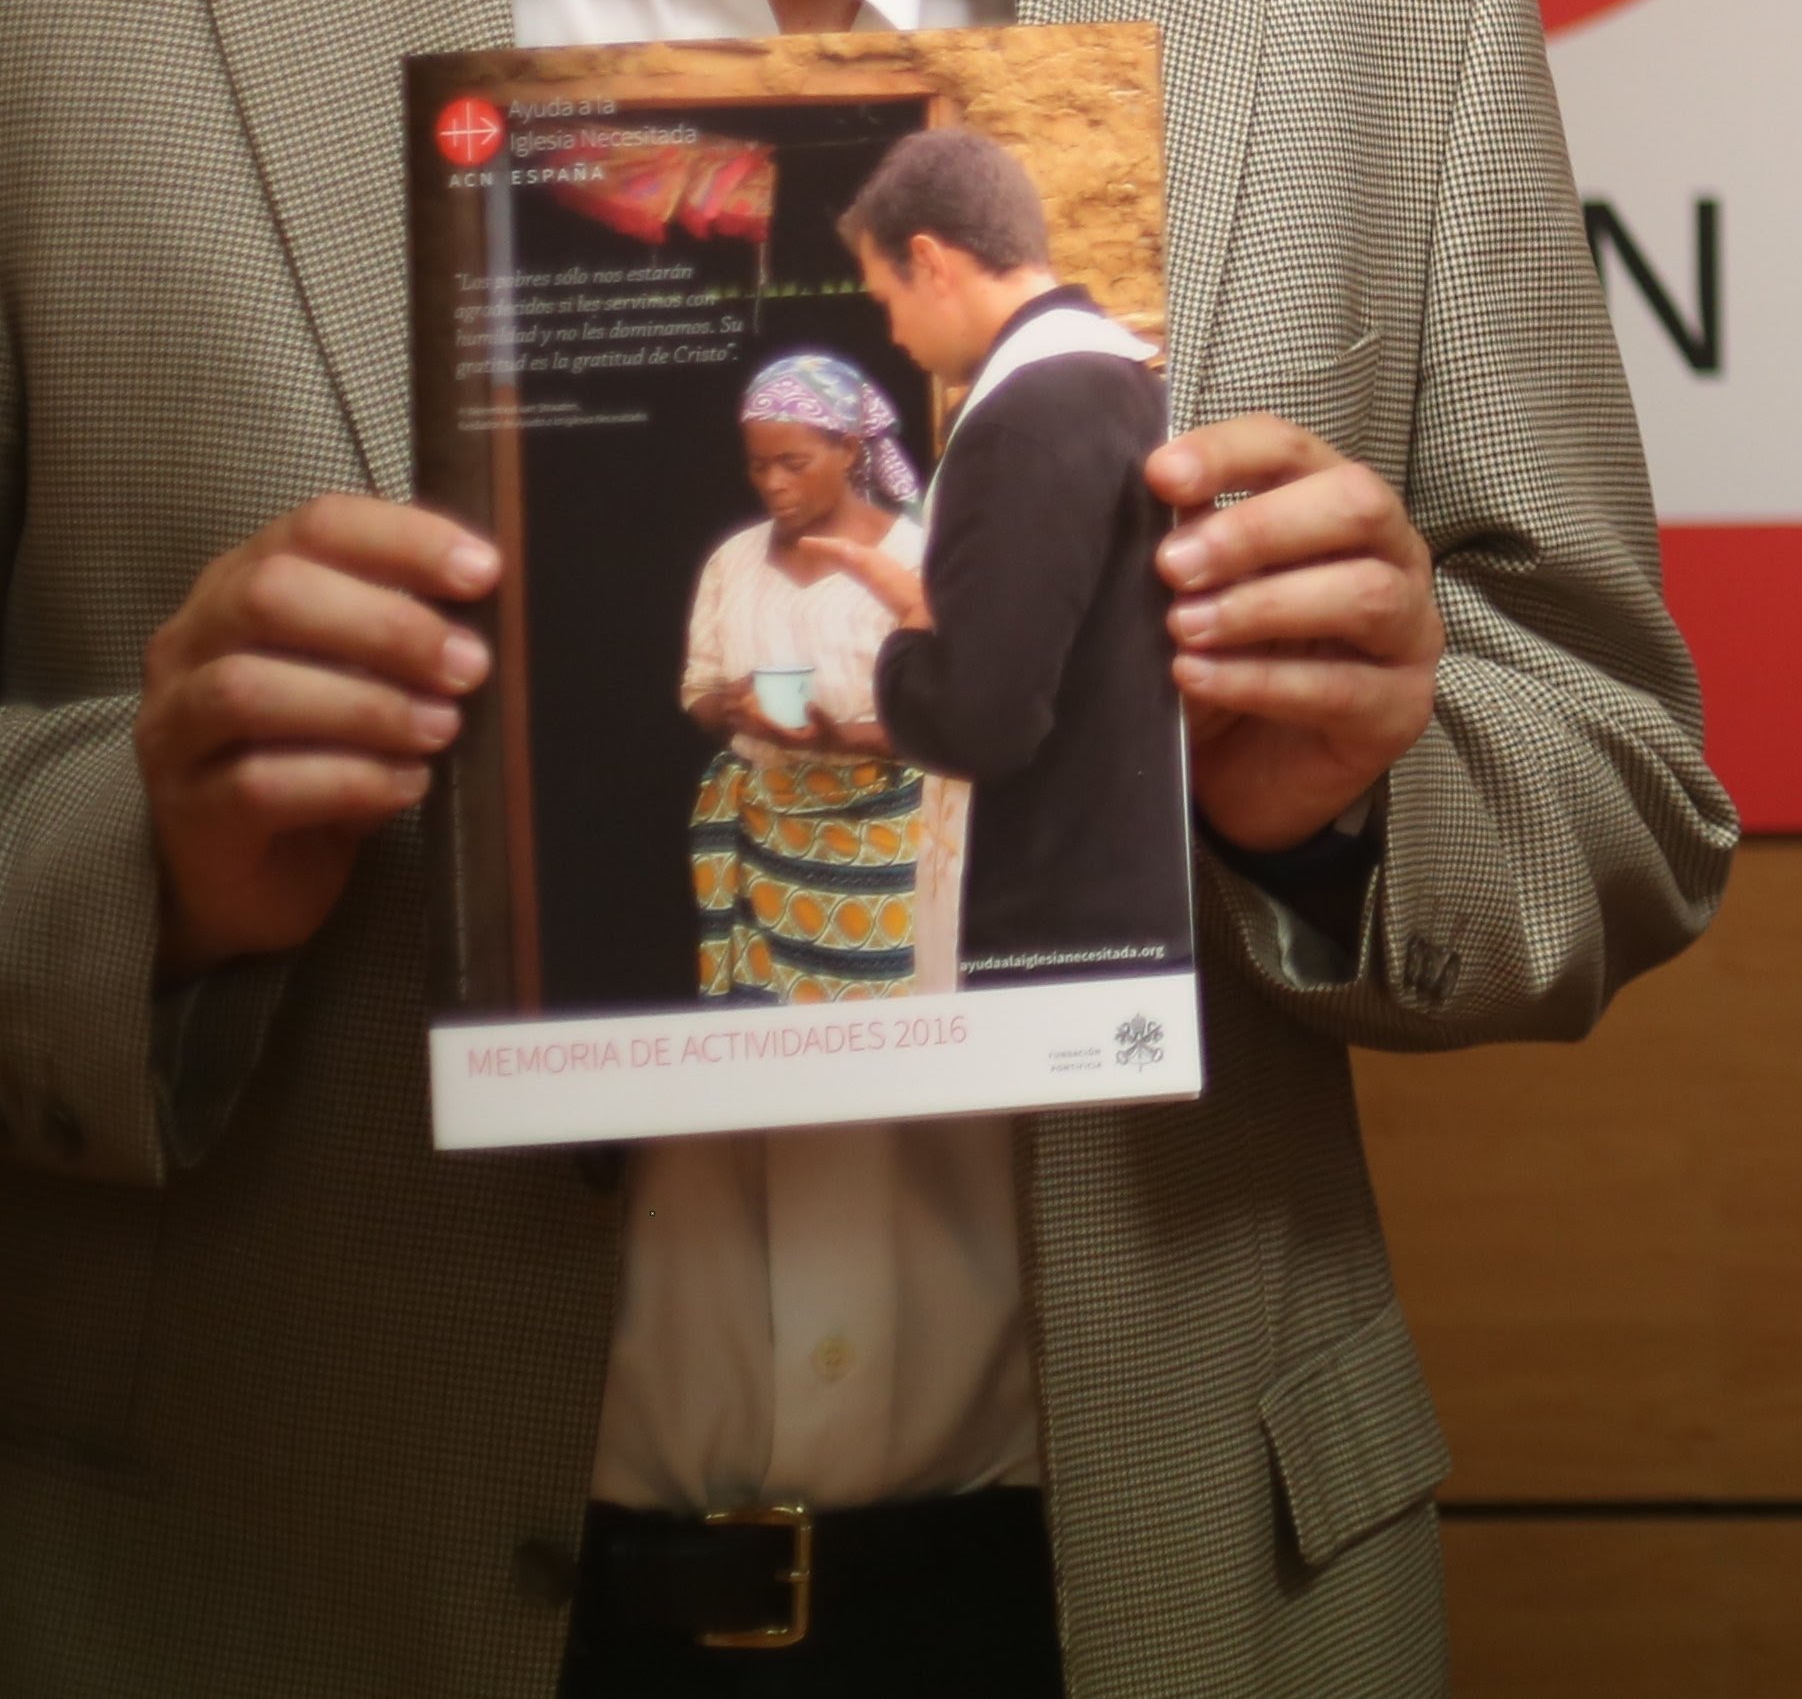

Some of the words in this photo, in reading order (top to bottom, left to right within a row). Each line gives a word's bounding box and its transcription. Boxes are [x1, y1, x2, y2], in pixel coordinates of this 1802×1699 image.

[508, 97, 573, 125] Ayuda
[579, 100, 592, 115] a
[596, 95, 618, 115] la
[510, 131, 575, 158] Iglesia
[580, 123, 699, 149] Necesitada
[448, 171, 494, 190] ACN
[511, 162, 606, 186] ESPAÑA
[593, 269, 623, 285] nos
[539, 327, 552, 348] y
[556, 327, 578, 341] no
[582, 320, 605, 341] les
[720, 315, 744, 334] Su
[529, 357, 549, 372] es
[552, 351, 569, 370] la
[648, 345, 668, 365] de
[959, 945, 1166, 975] ayudaalaiglesianecesitada.org
[466, 1038, 621, 1078] MEMORIA
[629, 1037, 672, 1068] DE
[680, 1020, 887, 1064] ACTIVIDADES
[894, 1014, 968, 1049] 2016
